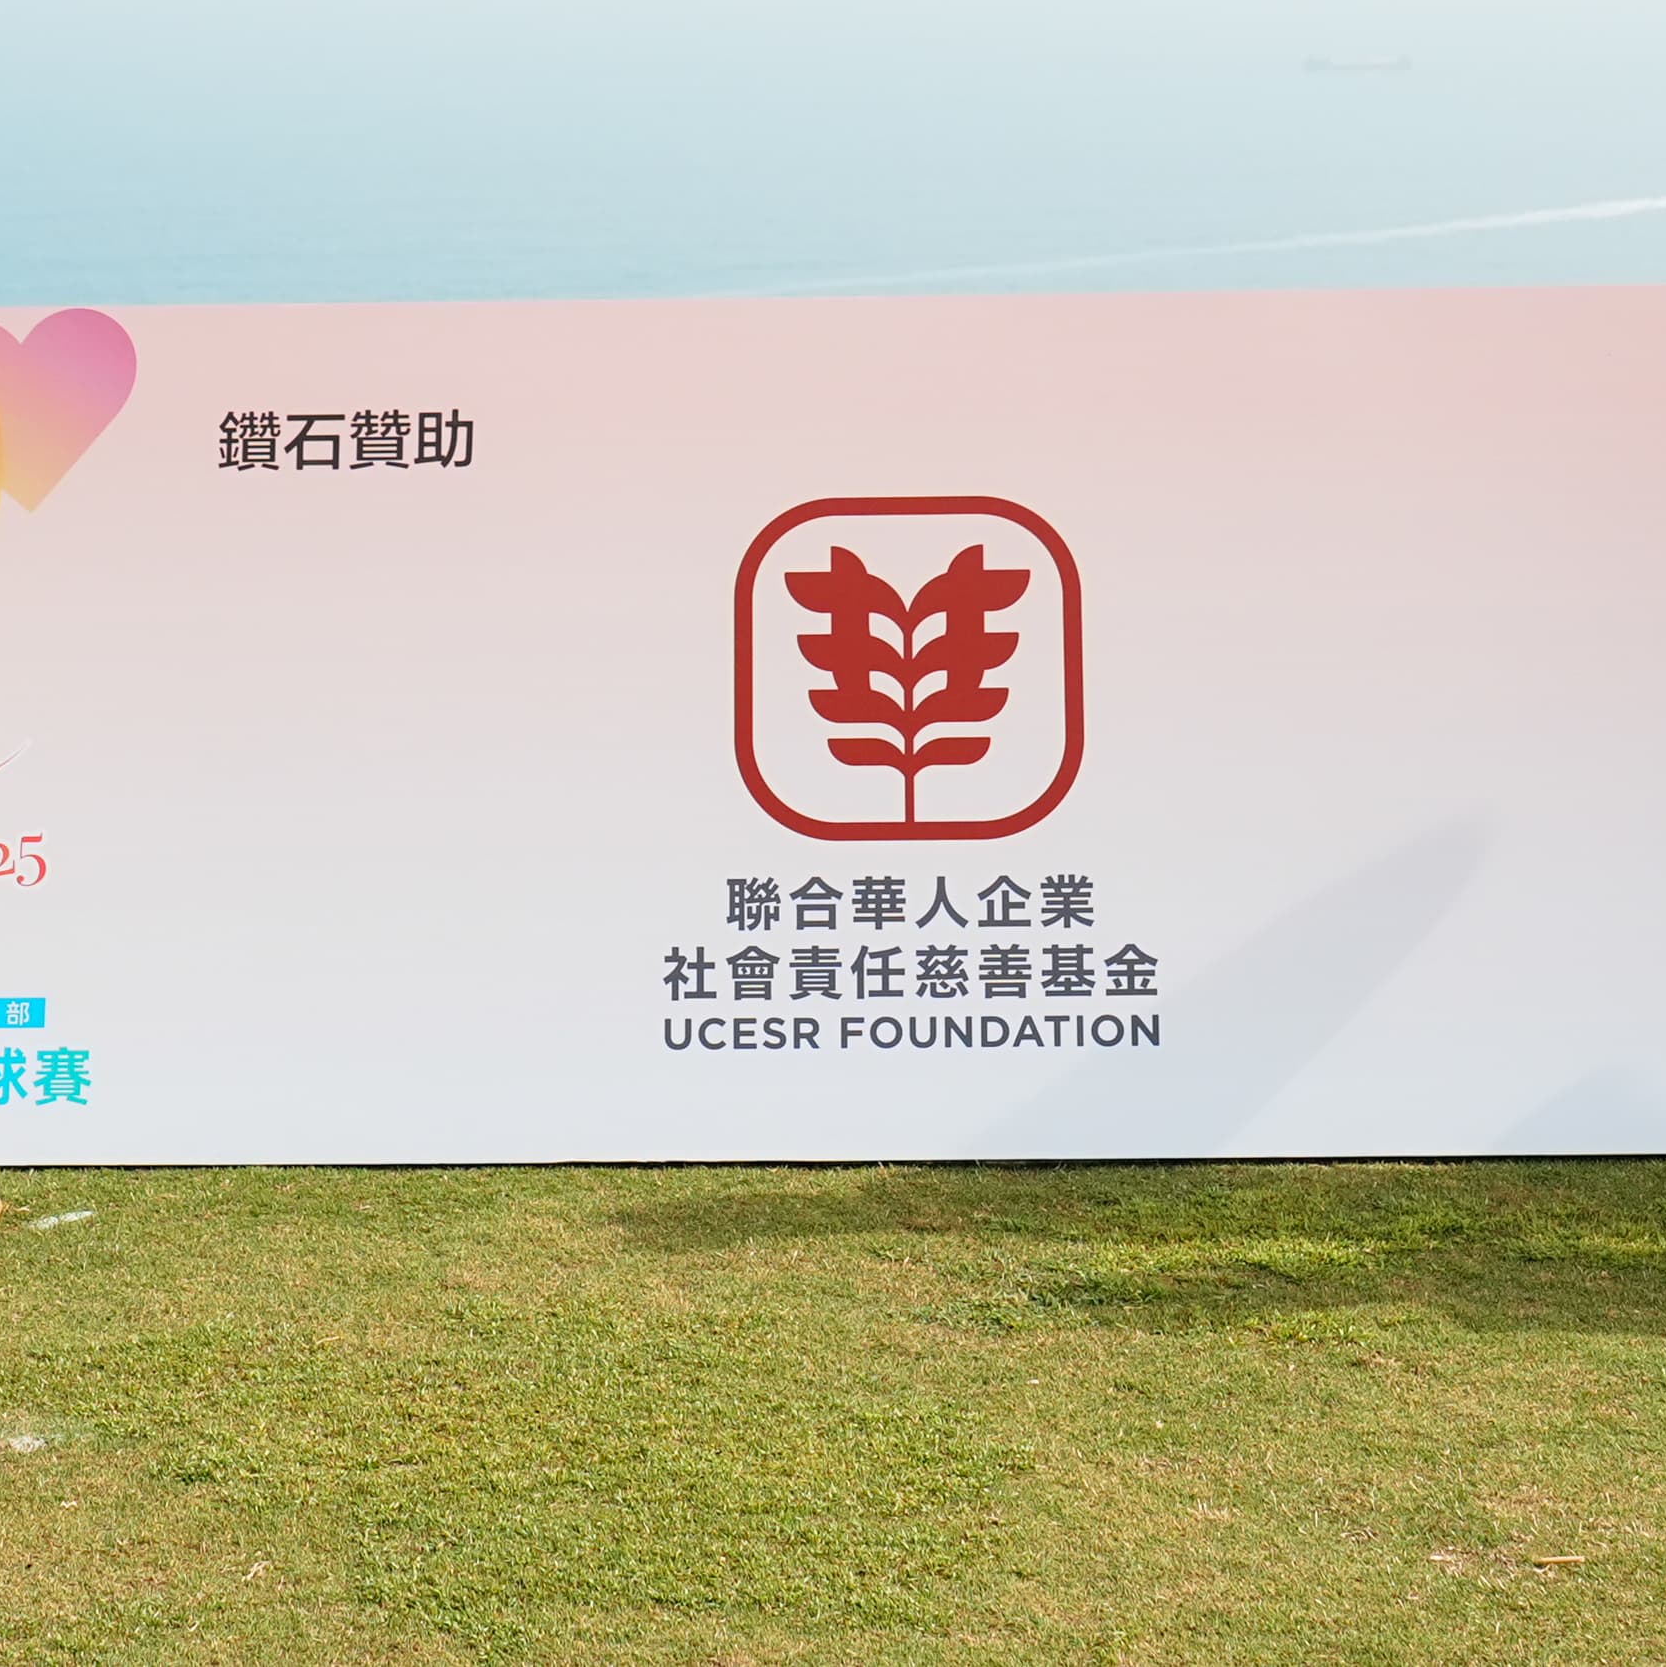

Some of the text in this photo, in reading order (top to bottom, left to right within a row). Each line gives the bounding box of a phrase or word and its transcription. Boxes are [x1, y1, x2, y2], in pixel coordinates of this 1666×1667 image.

[218, 409, 474, 471] 鑽石贊助
[726, 873, 1095, 932] 聯合華人企業
[662, 943, 1159, 1002] 社會責任慈善基金
[663, 1013, 1161, 1052] UCESR FOUNDATION
